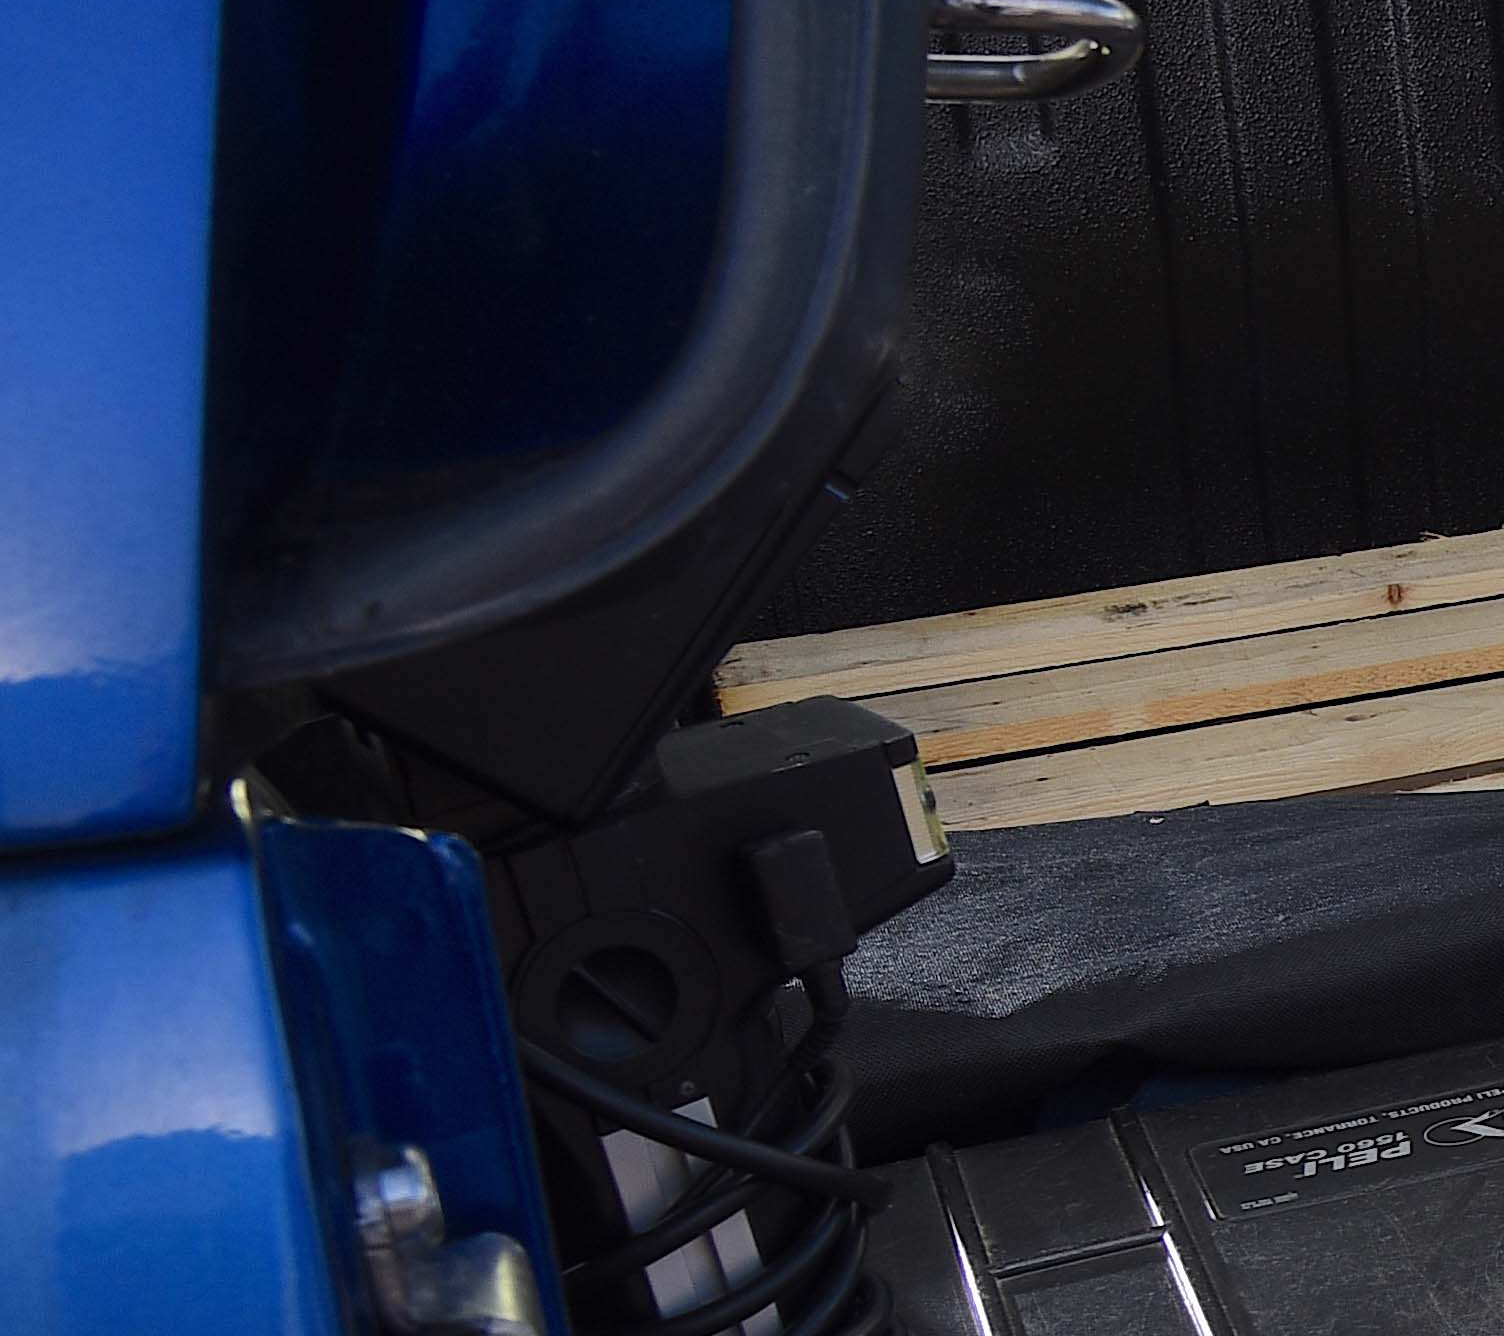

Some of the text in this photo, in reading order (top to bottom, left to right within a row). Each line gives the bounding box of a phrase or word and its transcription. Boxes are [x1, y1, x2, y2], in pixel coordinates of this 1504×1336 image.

[1381, 1093, 1474, 1121] PRODUCTS,
[1284, 1114, 1380, 1141] TORRANCE,
[1219, 1138, 1256, 1155] USA
[1244, 1130, 1410, 1176] 1560 CASE
[1258, 1134, 1283, 1149] CA
[1303, 1141, 1415, 1179] PELI
